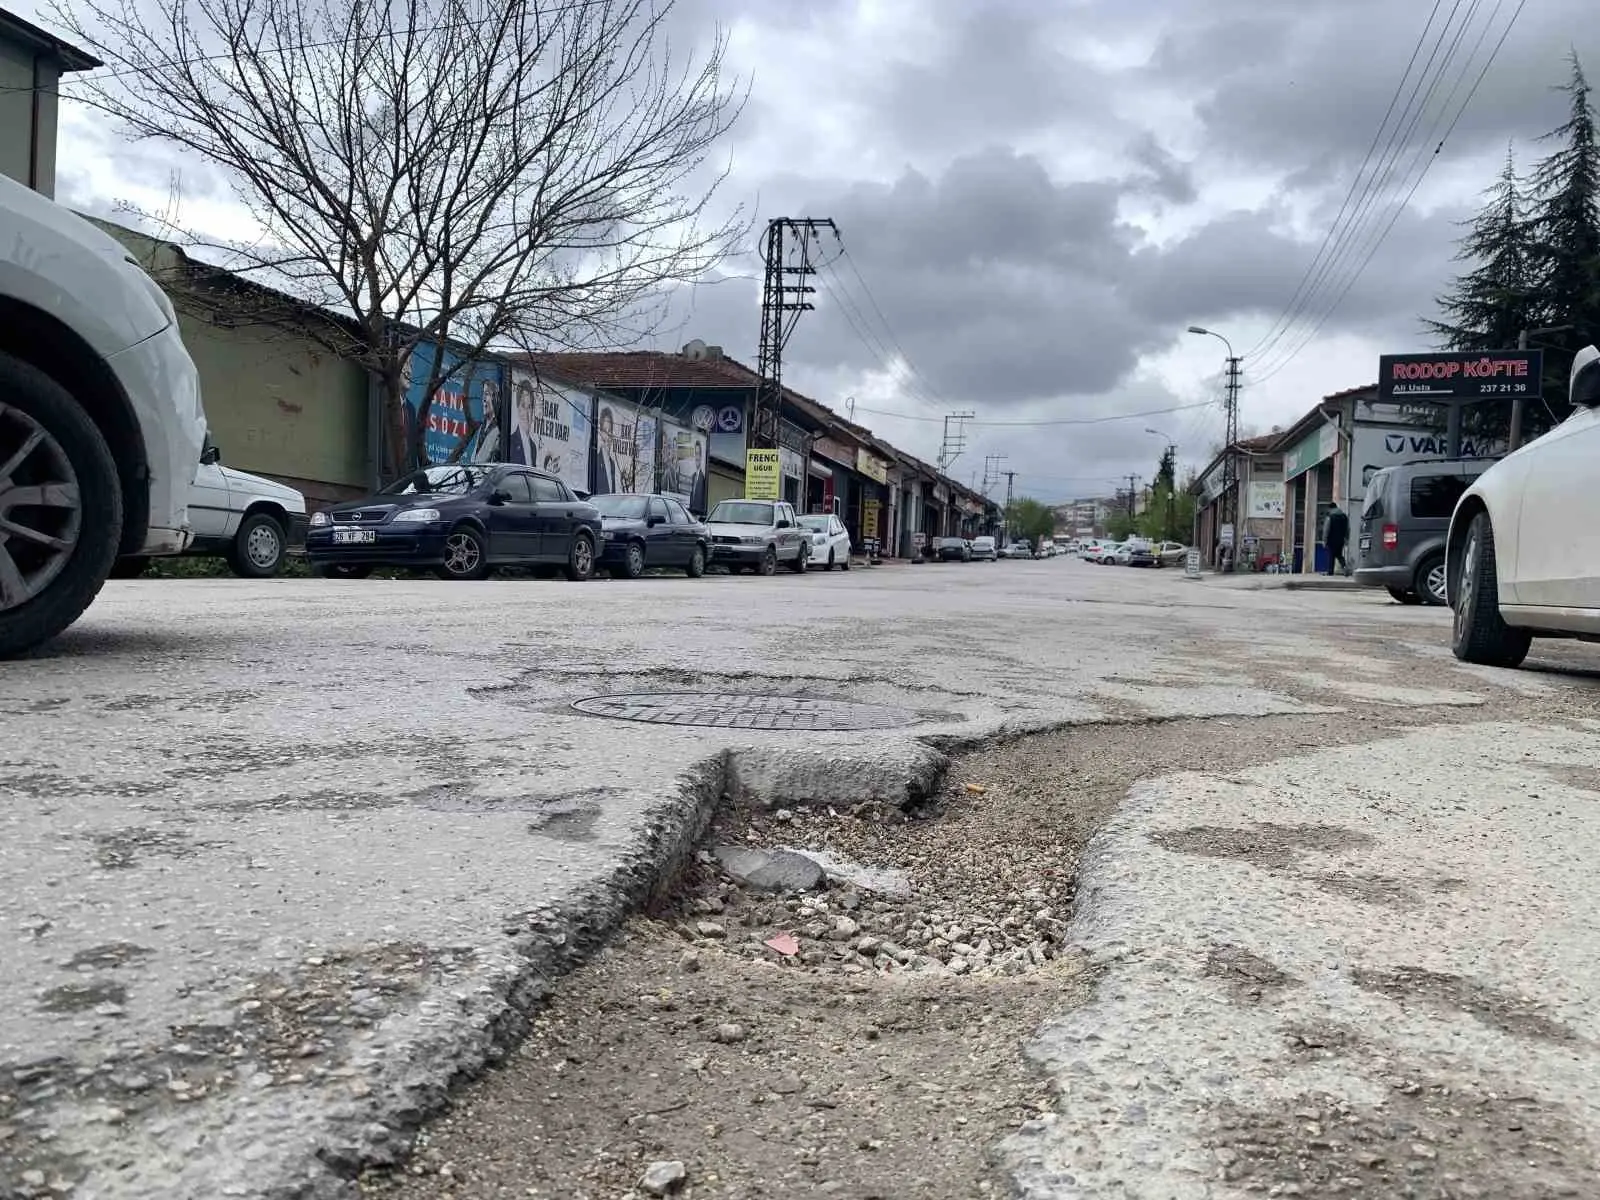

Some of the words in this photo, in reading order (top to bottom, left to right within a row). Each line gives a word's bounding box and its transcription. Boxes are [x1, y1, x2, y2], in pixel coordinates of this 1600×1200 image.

[1392, 362, 1460, 380] RODOP
[1463, 357, 1529, 378] KÖFTE
[1480, 384, 1498, 393] 237
[1410, 437, 1477, 456] VARA
